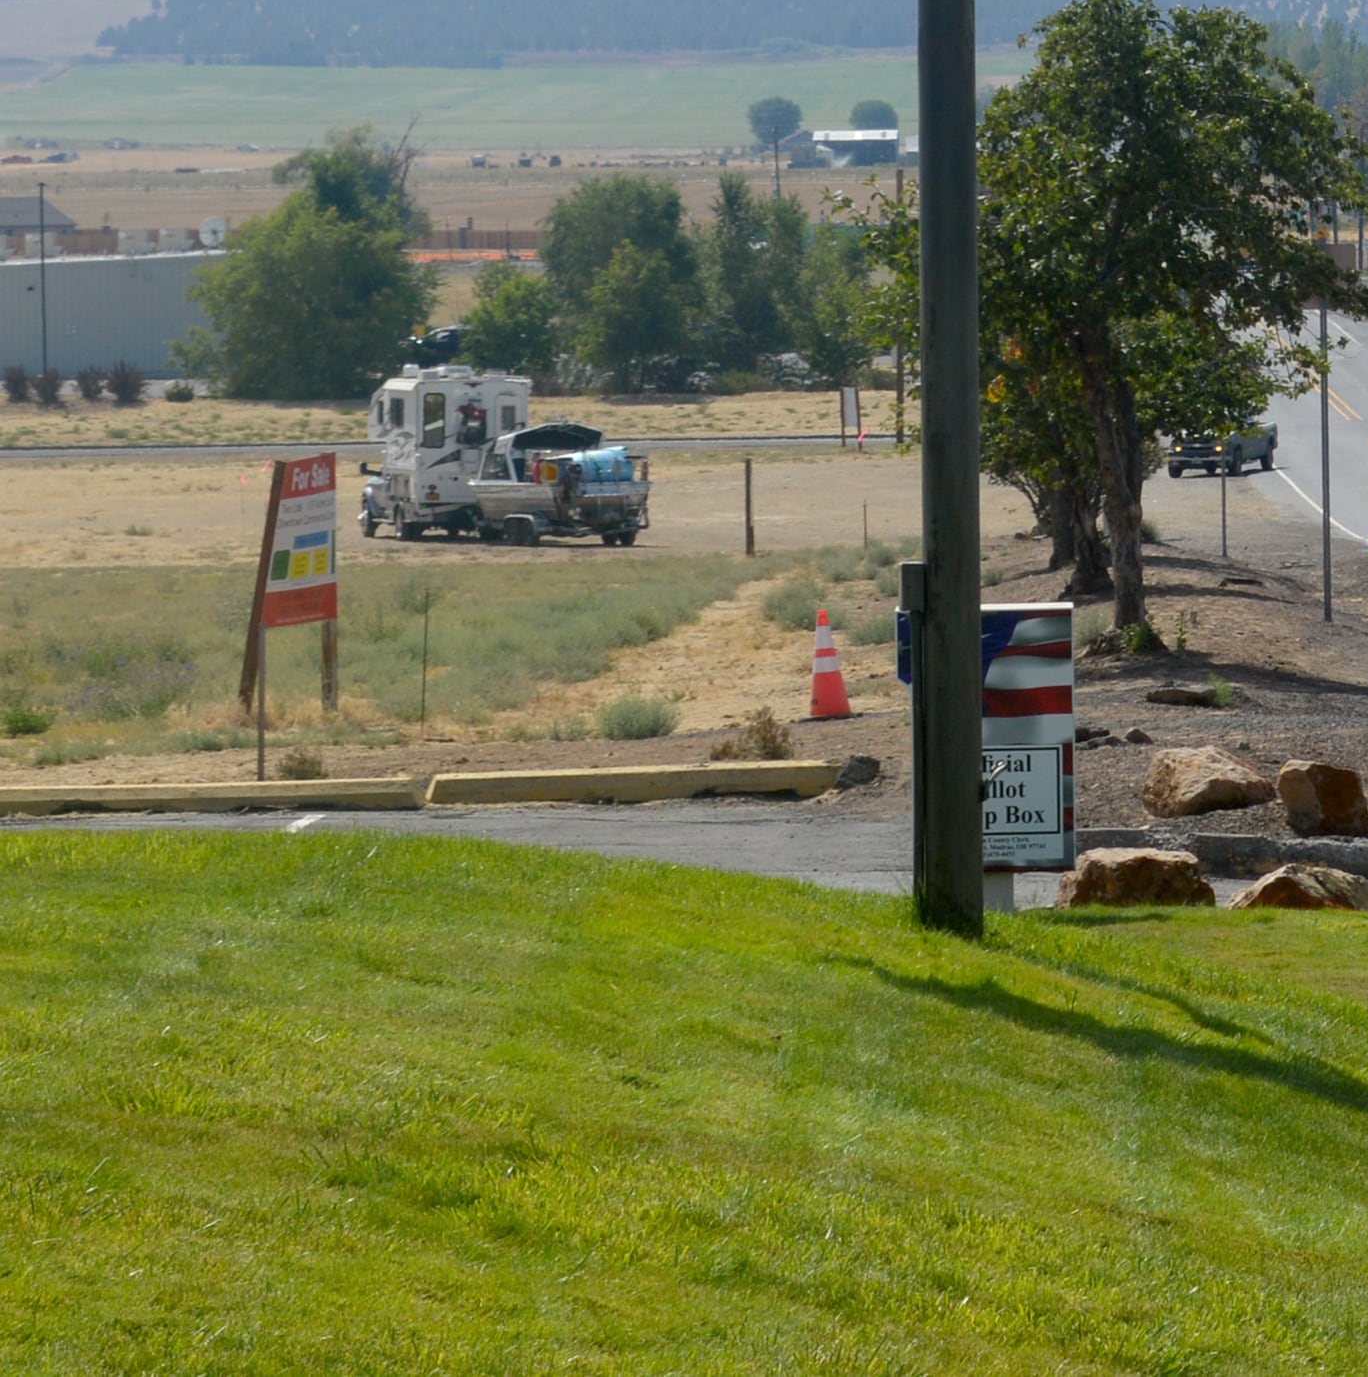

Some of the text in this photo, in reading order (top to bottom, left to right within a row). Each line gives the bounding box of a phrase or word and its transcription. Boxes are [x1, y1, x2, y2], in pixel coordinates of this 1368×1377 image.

[291, 461, 331, 493] For Sale
[1005, 805, 1046, 824] Box
